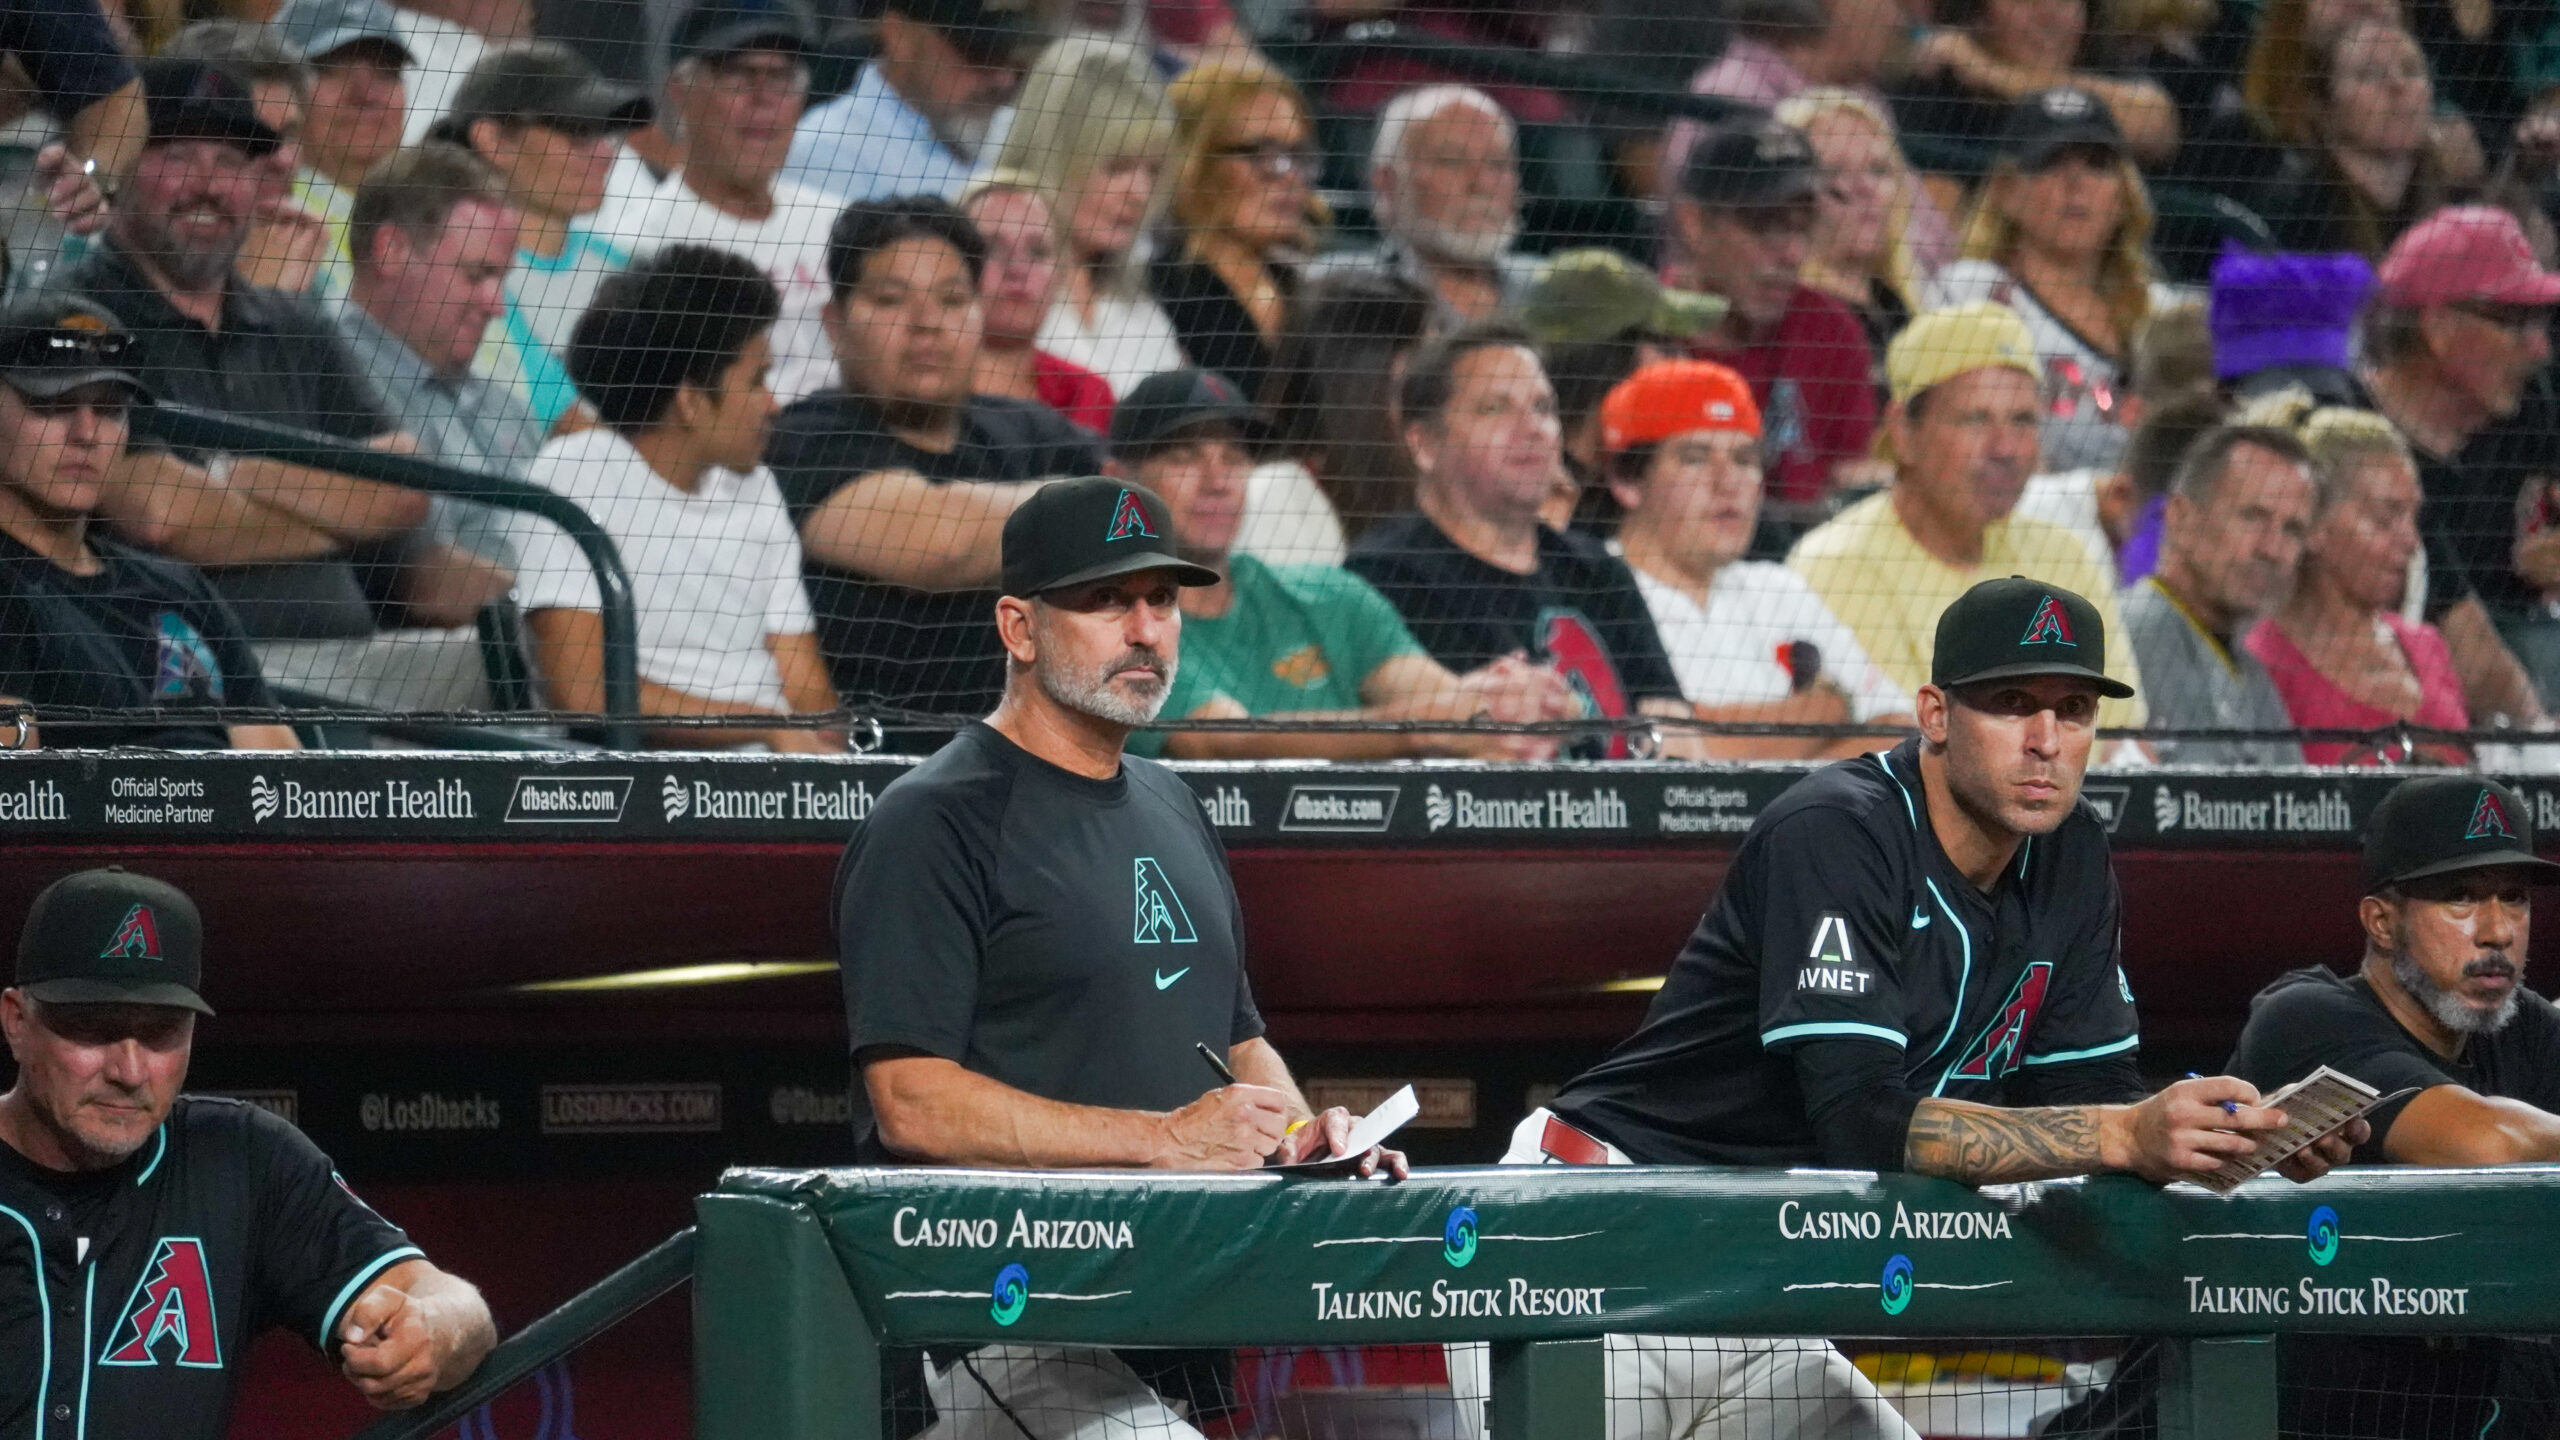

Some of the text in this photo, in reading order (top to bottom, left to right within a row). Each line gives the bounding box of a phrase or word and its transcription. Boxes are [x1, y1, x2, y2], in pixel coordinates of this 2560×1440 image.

[0, 780, 67, 820] ealth
[111, 777, 204, 801] Official Sports
[283, 778, 475, 819] Banner Health
[521, 786, 615, 811] dbacks.com
[694, 780, 874, 820] Banner Health
[1203, 786, 1252, 826] alth
[1455, 787, 1628, 829] Banner Health
[105, 803, 214, 823] Medicine Partner
[2183, 788, 2351, 832] Banner Health
[1797, 967, 1870, 993] AVNET
[359, 1093, 501, 1131] @LosDbacks
[769, 1086, 851, 1125] @Dbac
[893, 1206, 1134, 1249] CASINO ARIZONA
[1778, 1200, 2012, 1239] CASINO ARIZONA
[1311, 1277, 1606, 1320] TALKING STICK RESORT
[2183, 1276, 2469, 1315] TALKING STICK RESORT
